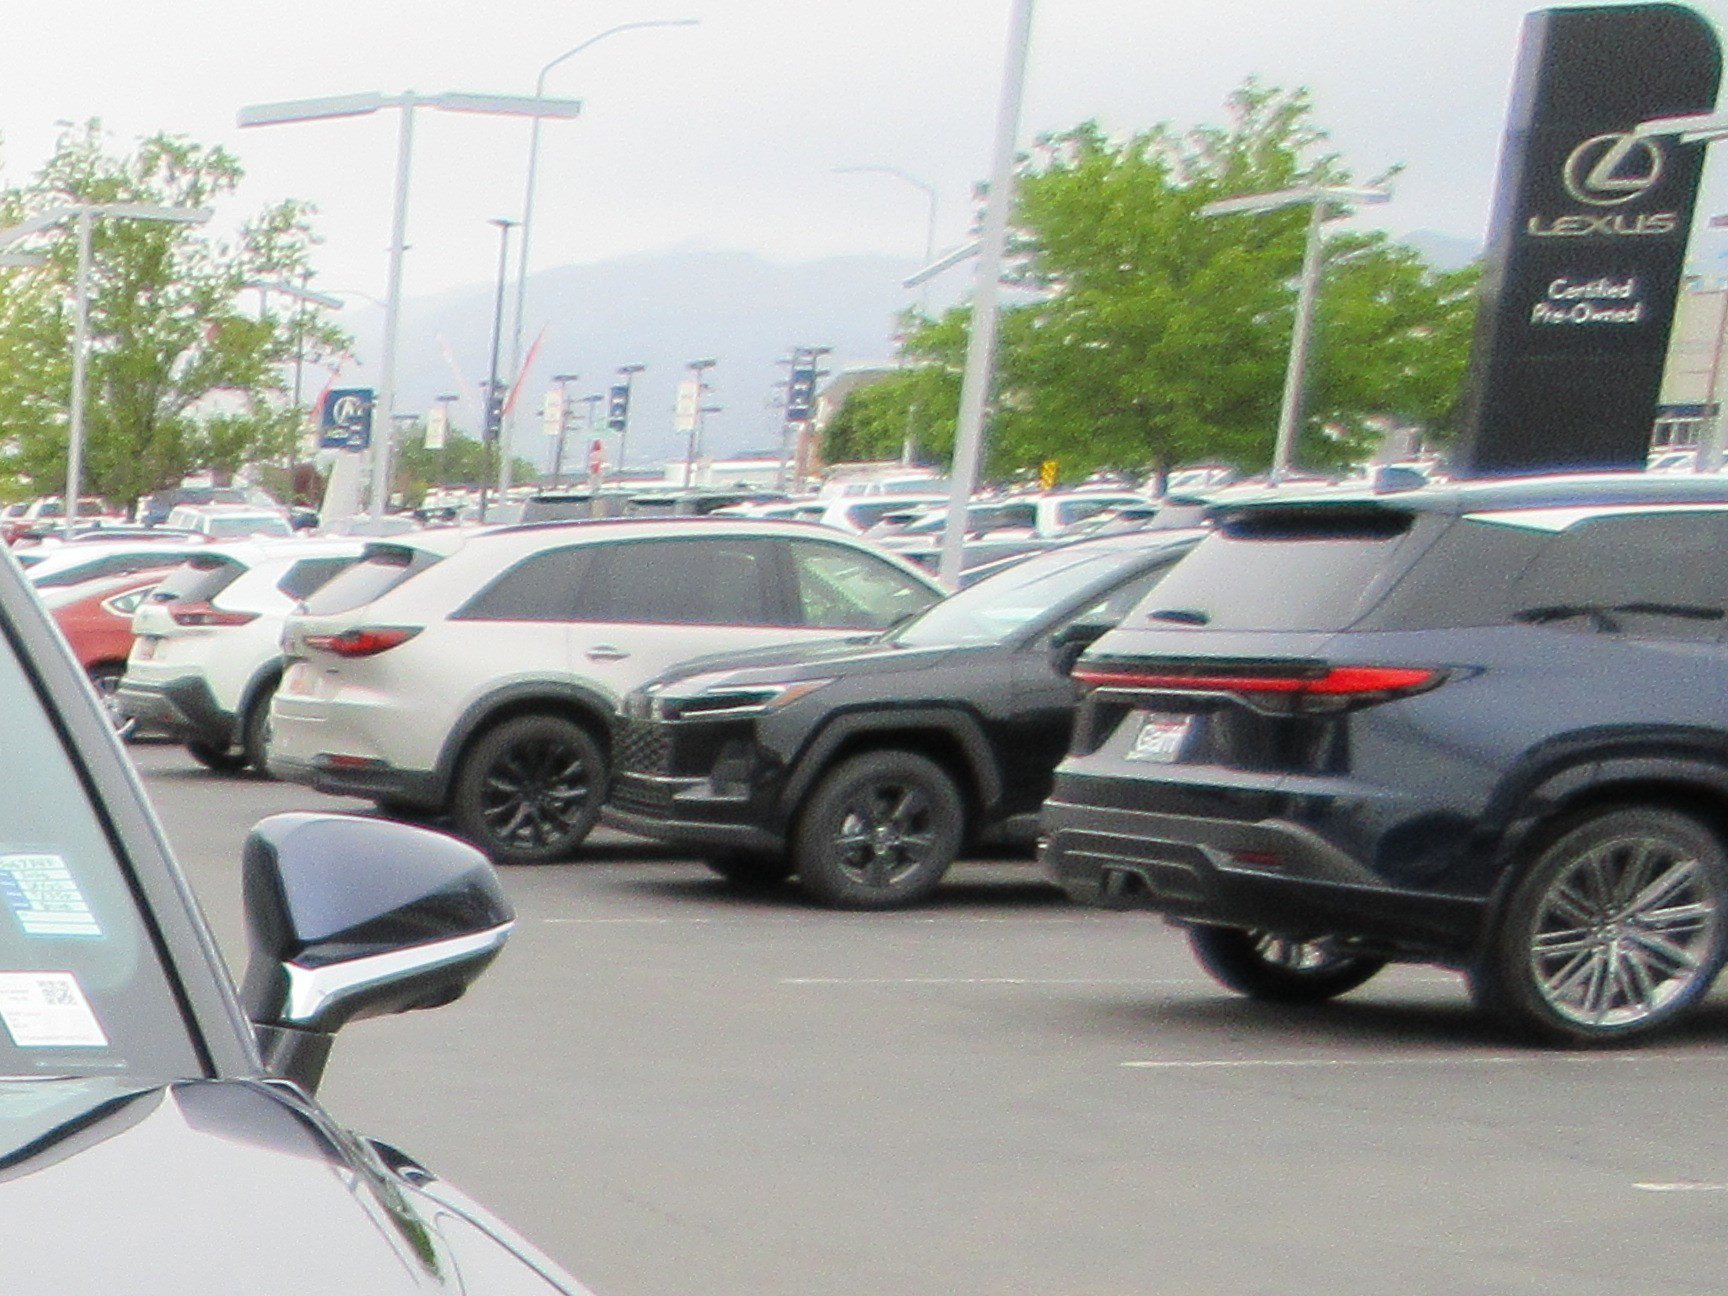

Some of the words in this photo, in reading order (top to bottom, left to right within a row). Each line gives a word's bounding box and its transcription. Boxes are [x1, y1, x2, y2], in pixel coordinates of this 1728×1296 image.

[1526, 212, 1678, 237] LEXUS
[1547, 276, 1635, 300] Certified
[1529, 302, 1644, 325] Pre-Owned
